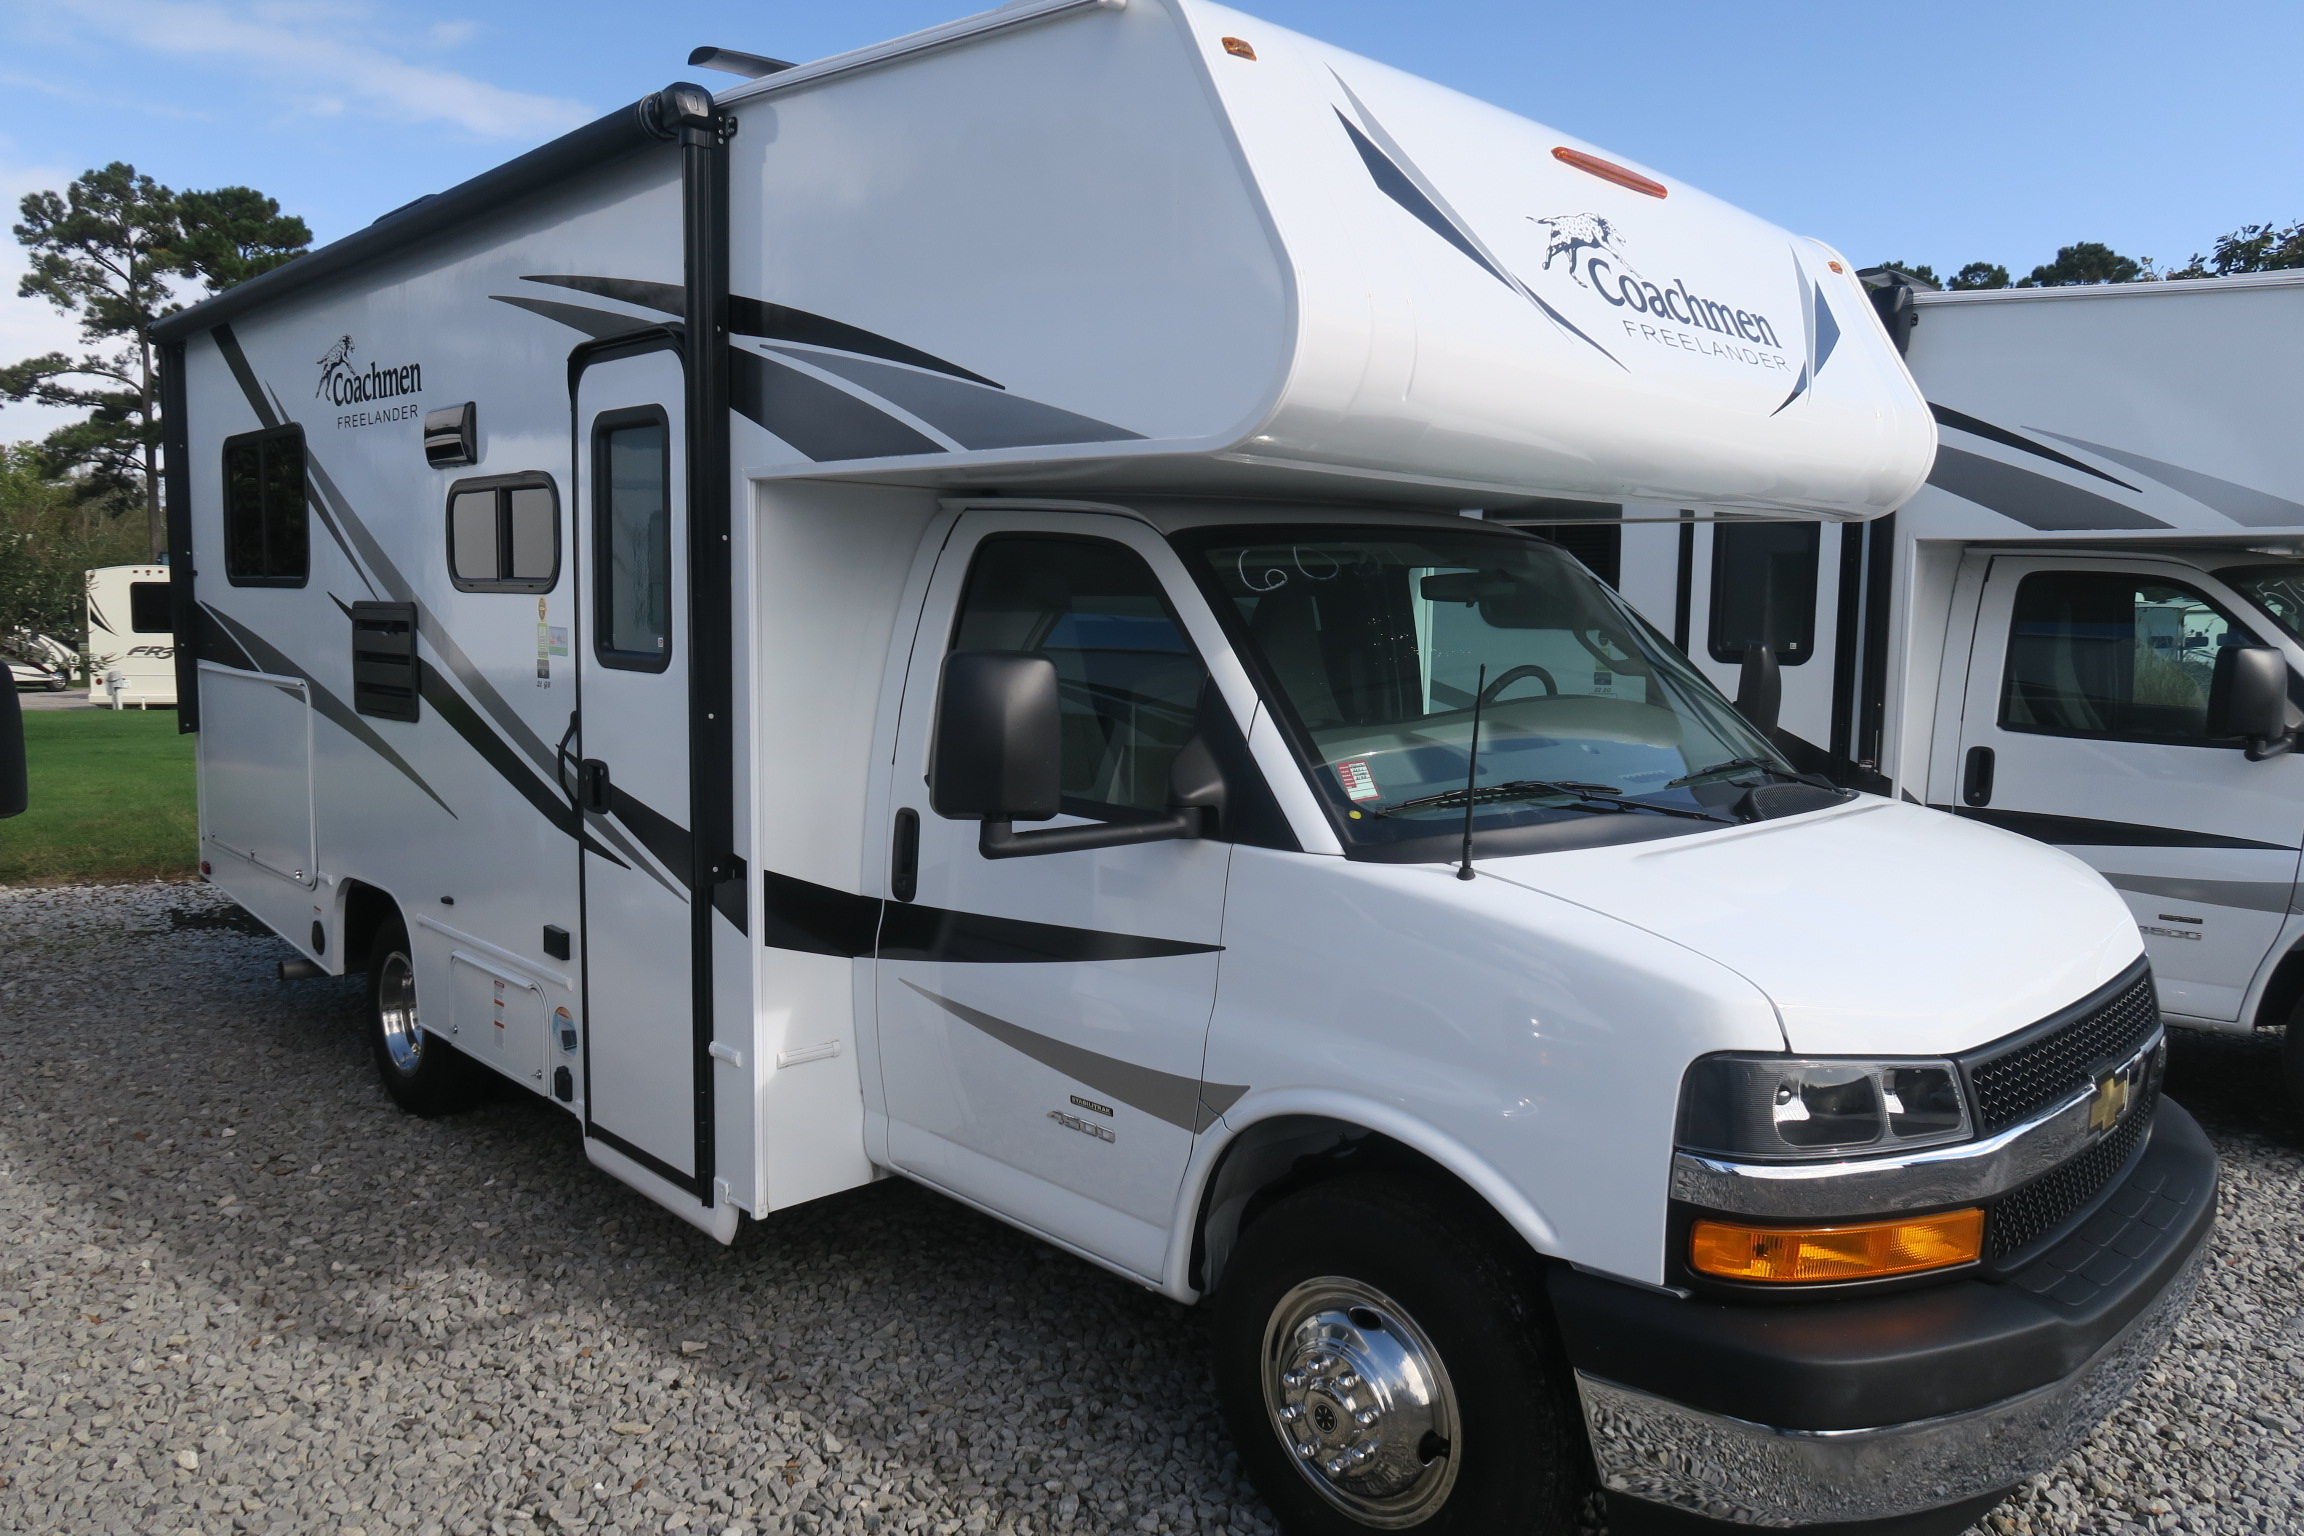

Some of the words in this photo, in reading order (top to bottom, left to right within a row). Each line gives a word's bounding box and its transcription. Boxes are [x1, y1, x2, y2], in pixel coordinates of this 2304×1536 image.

[1587, 257, 1782, 349] Coachmen
[1622, 319, 1791, 372] FREELANDER
[332, 361, 422, 407] Coachmen
[337, 404, 419, 430] FREELANDER
[1070, 1096, 1112, 1116] STABILITRAK
[1047, 1110, 1116, 1144] 4500
